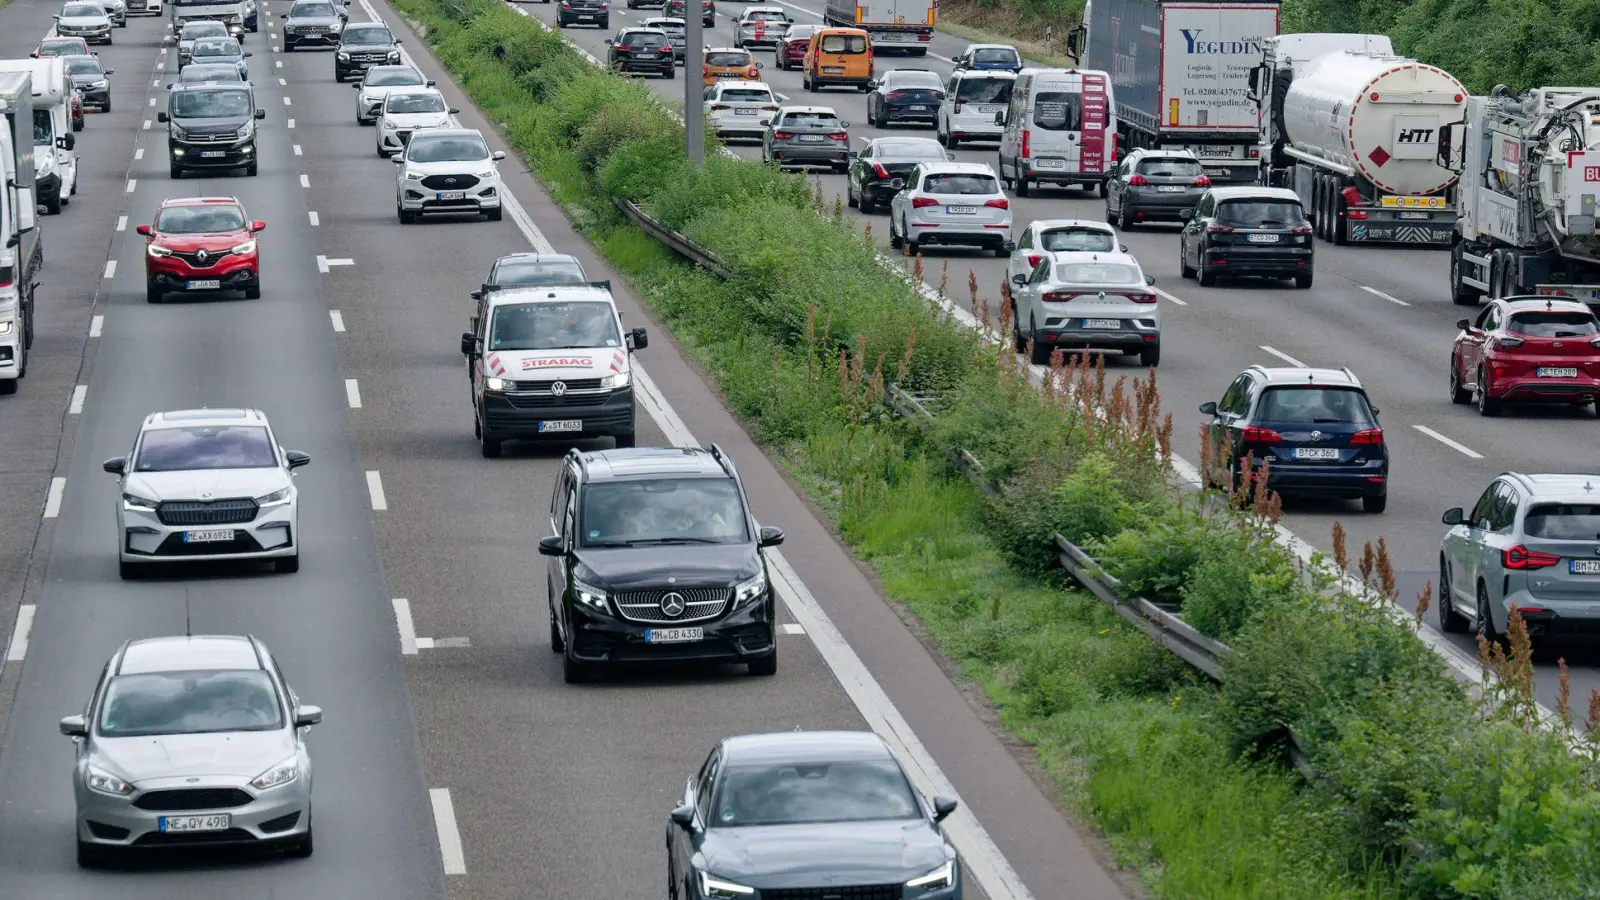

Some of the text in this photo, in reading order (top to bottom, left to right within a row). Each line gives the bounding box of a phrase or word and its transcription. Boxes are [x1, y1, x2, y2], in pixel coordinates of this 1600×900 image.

[1179, 29, 1262, 54] YEGUDIN
[1198, 88, 1247, 96] 0208/437672
[1187, 99, 1251, 108] www.yegudin.de
[1398, 129, 1434, 142] HTT
[1576, 562, 1586, 570] BM
[652, 628, 702, 637] MH CB 4330
[167, 816, 227, 829] NE QY 498
